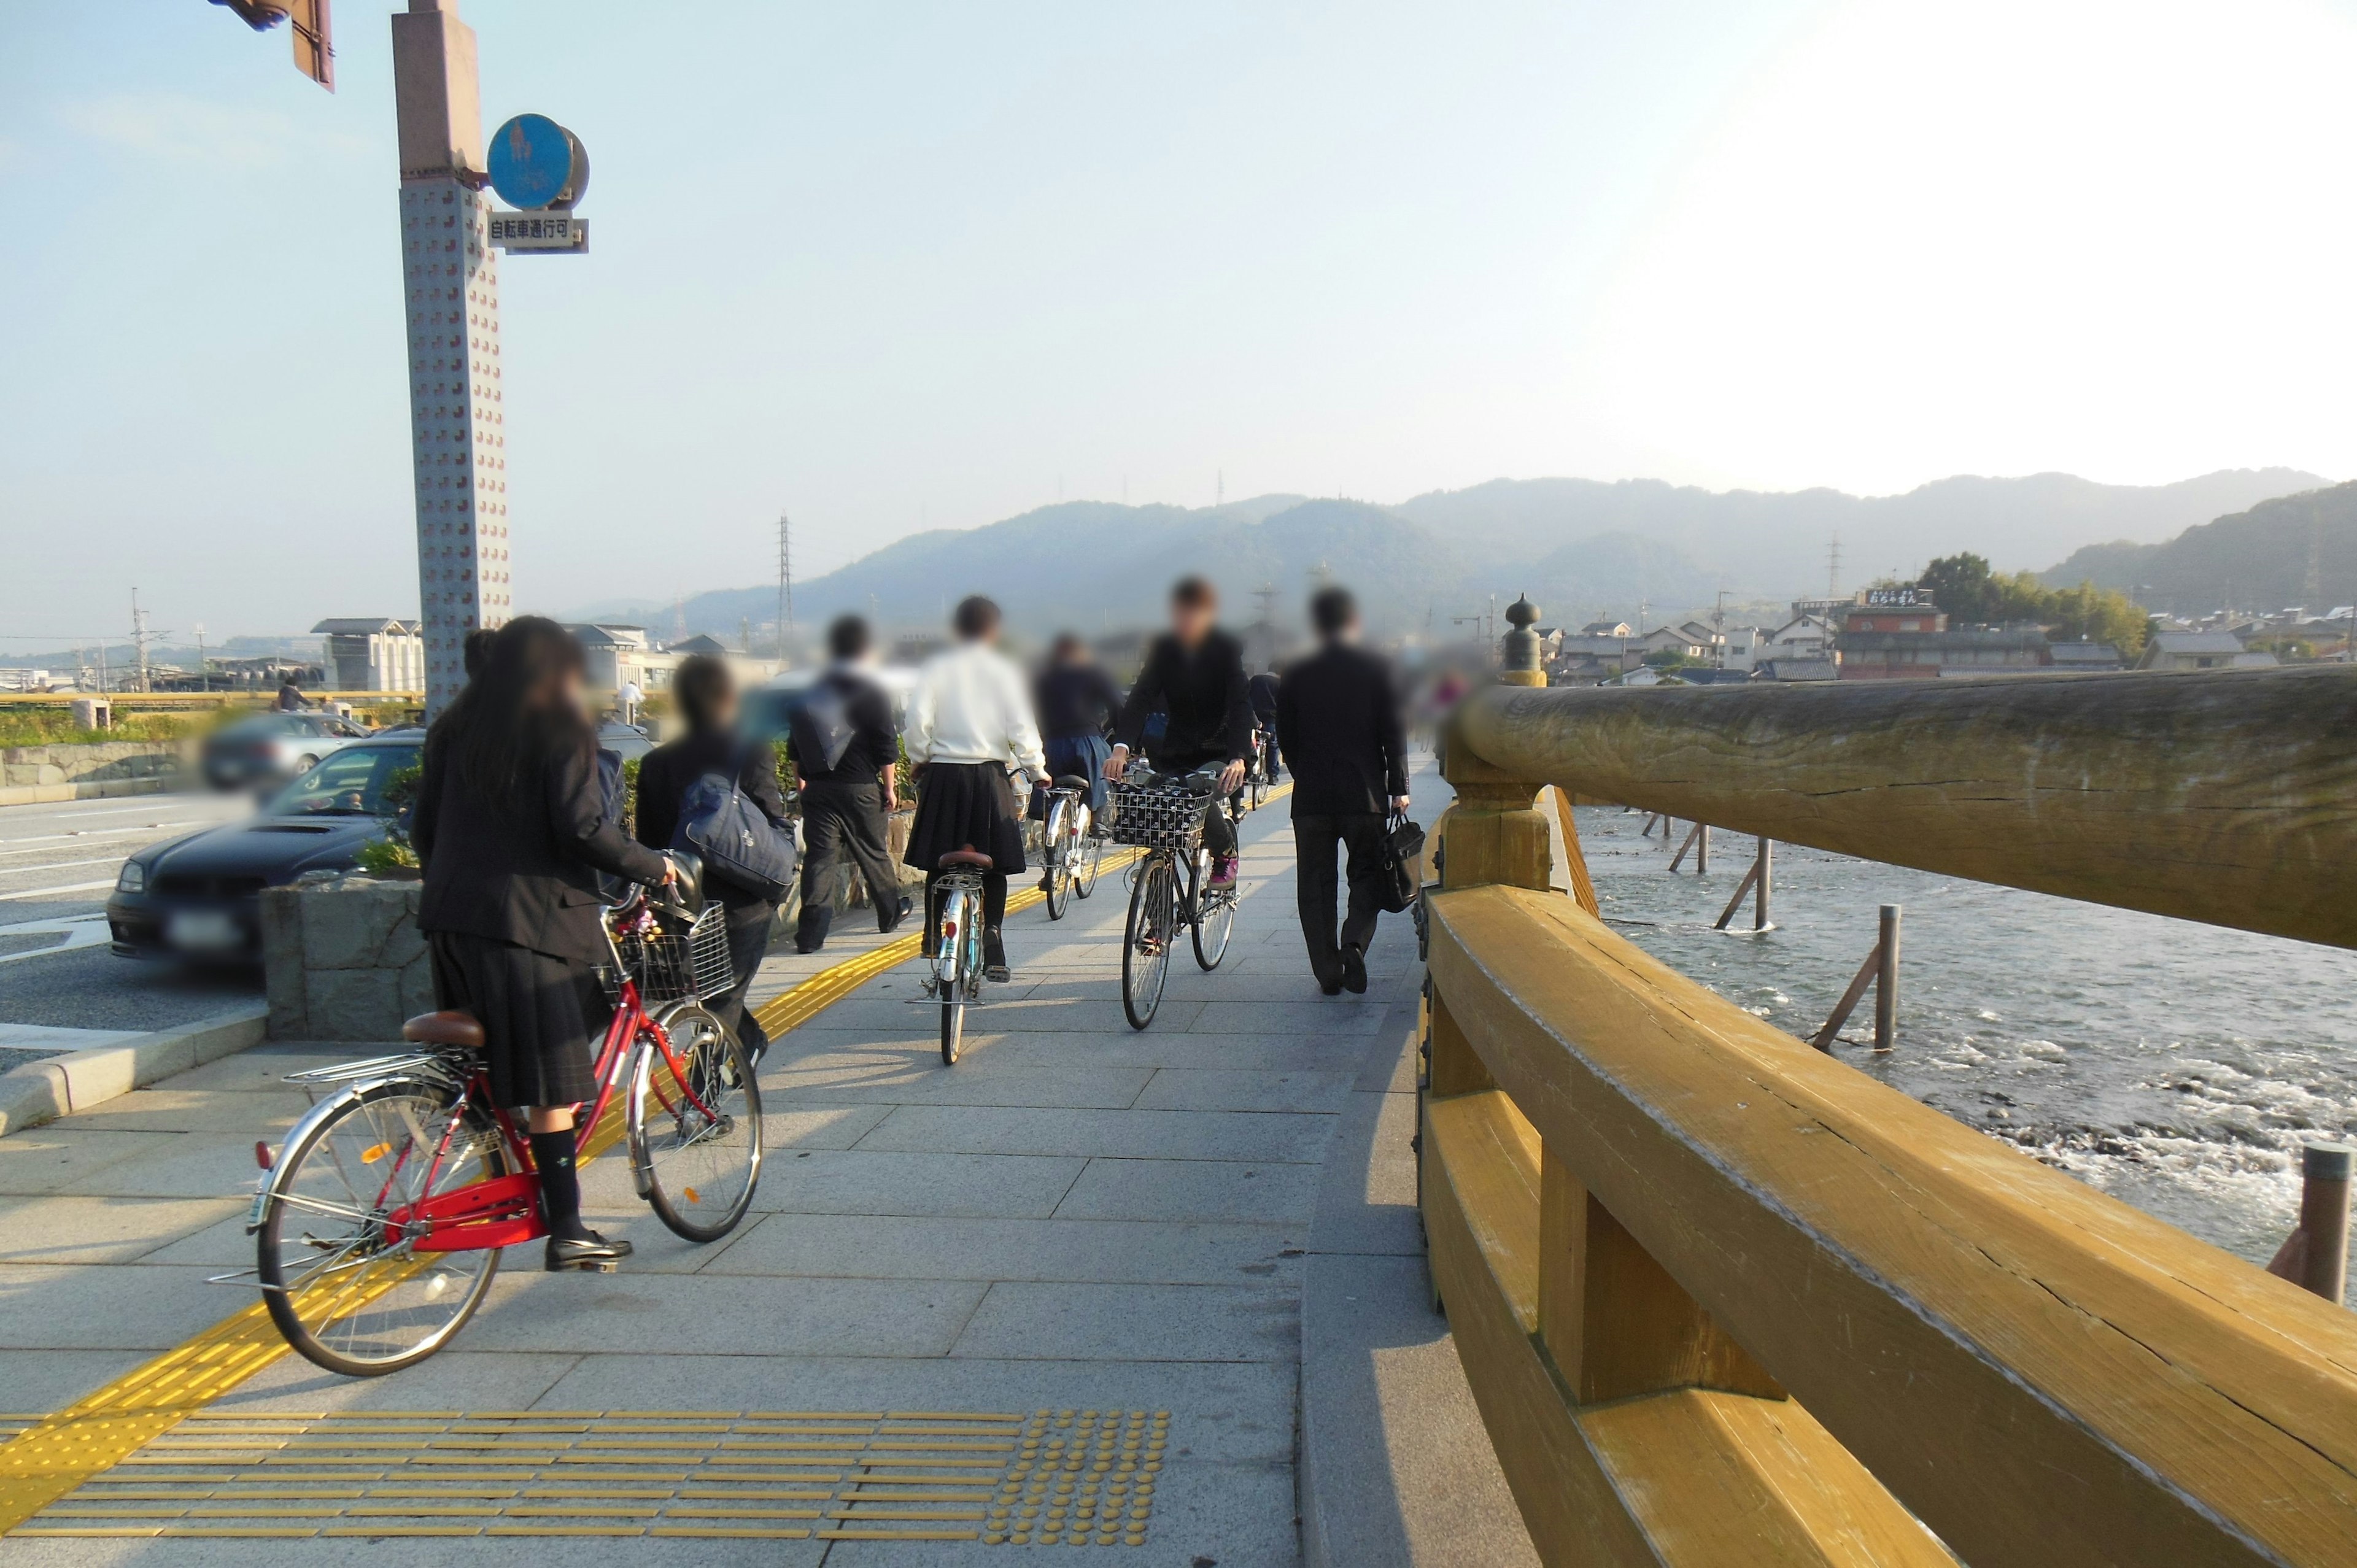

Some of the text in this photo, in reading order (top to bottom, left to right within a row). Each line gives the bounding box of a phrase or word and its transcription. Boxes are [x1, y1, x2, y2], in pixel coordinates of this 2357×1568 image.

[492, 220, 568, 239] 自転車通行可
